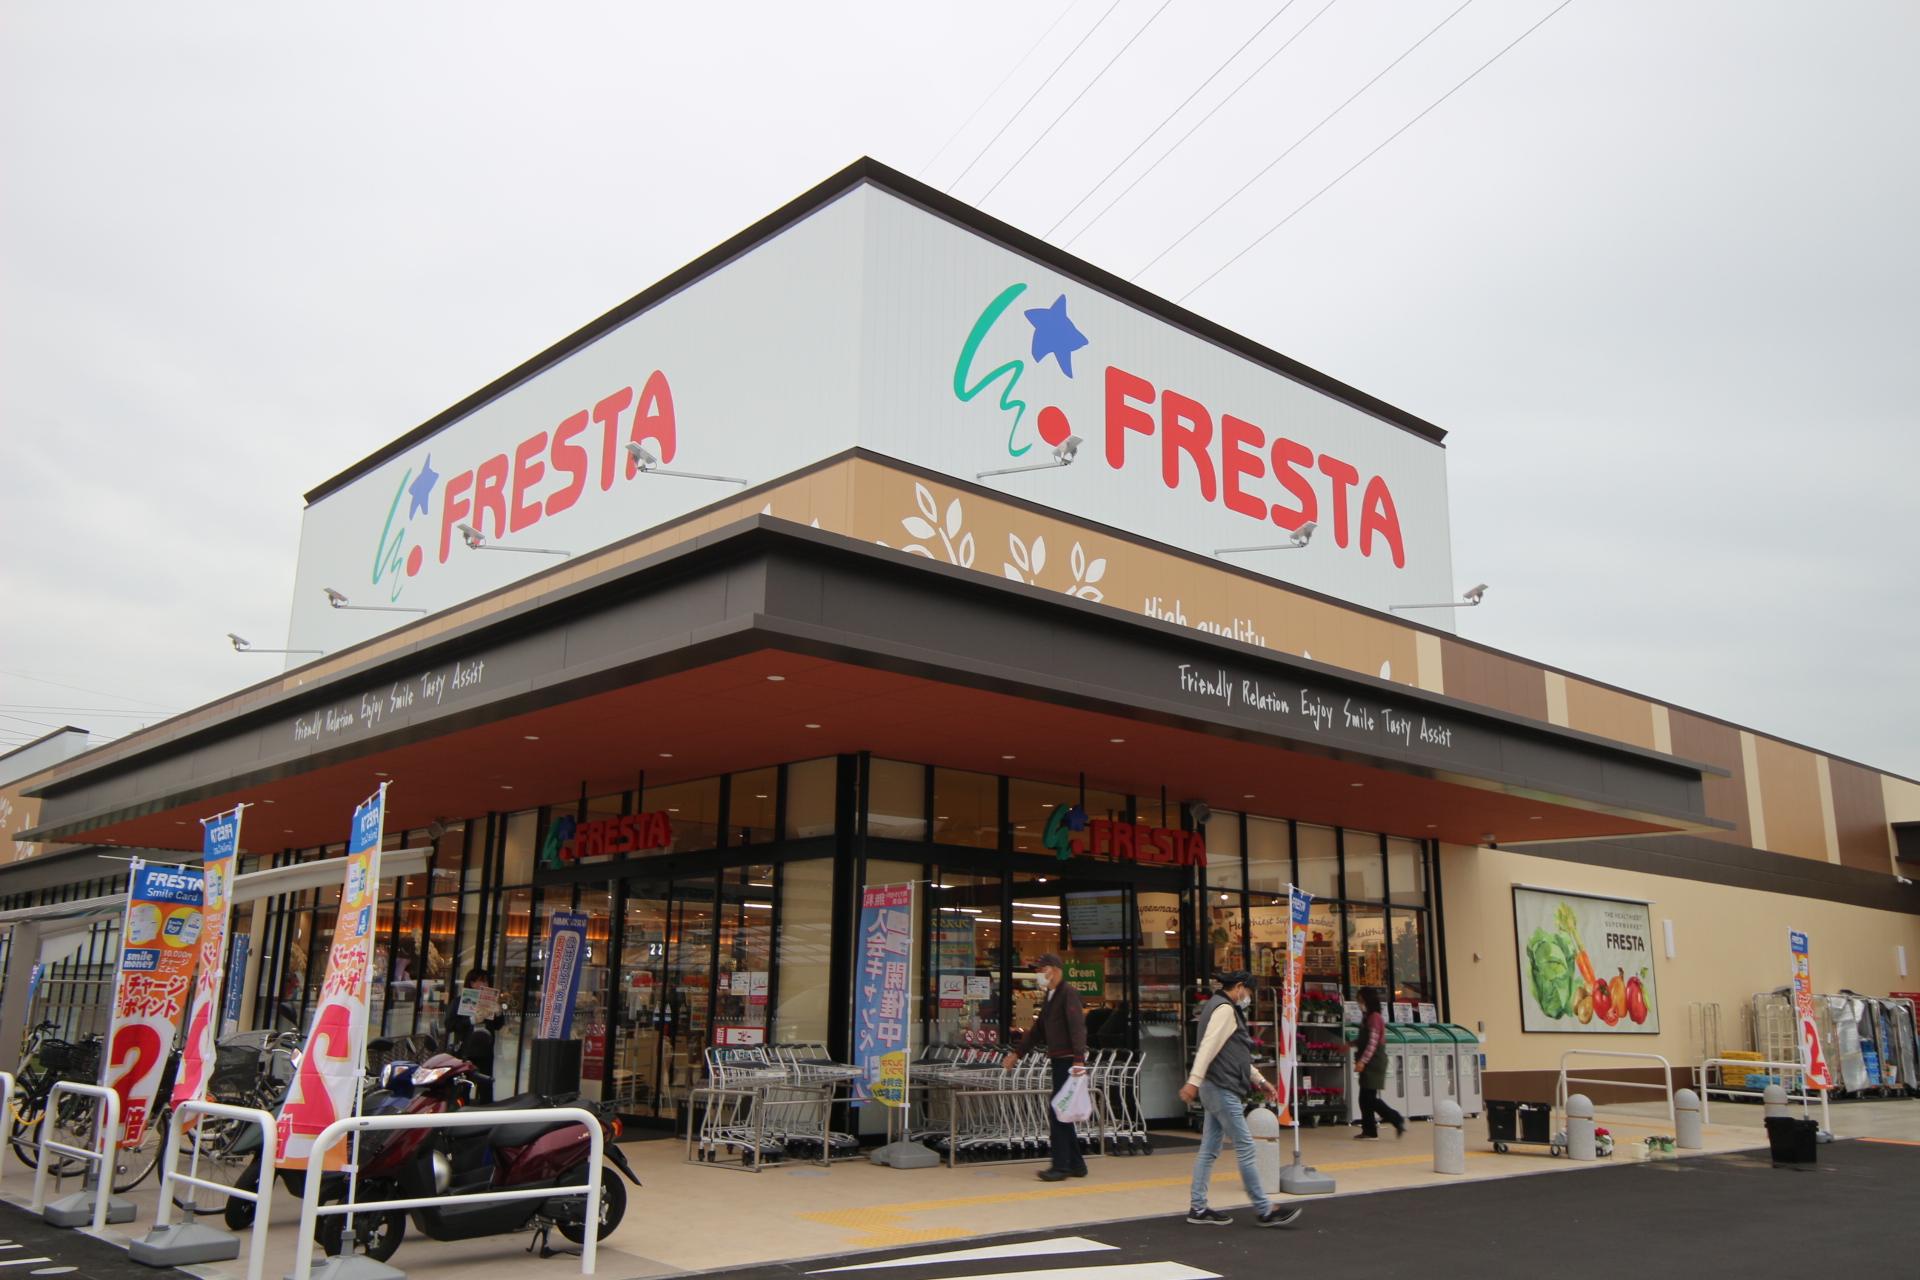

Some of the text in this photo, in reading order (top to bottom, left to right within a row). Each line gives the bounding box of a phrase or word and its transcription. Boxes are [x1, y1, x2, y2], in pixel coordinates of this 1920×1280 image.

[439, 370, 676, 564] FRESTA
[1105, 366, 1405, 569] FRESTA
[295, 660, 485, 740] Friendly Relation Enjoy Smile Tasty Assist
[1178, 664, 1452, 747] Friendly Relation Enjoy Smile Tasty Assist
[574, 810, 672, 858] FRESTA
[1090, 818, 1208, 867] FRESTA
[146, 871, 204, 892] FRESTA
[147, 887, 199, 902] Smile Card
[1604, 911, 1642, 921] THE HEALTHIEST
[167, 924, 182, 933] Pay
[1605, 920, 1643, 931] SUPERMARKET
[1606, 932, 1645, 952] FRESTA
[126, 951, 153, 961] smile
[160, 957, 190, 967] チャージ
[123, 960, 155, 970] money
[158, 965, 180, 974] ごとに
[1069, 967, 1096, 978] Green
[128, 973, 189, 997] チャージ
[1067, 981, 1098, 991] RESTA
[122, 996, 180, 1018] ポイント
